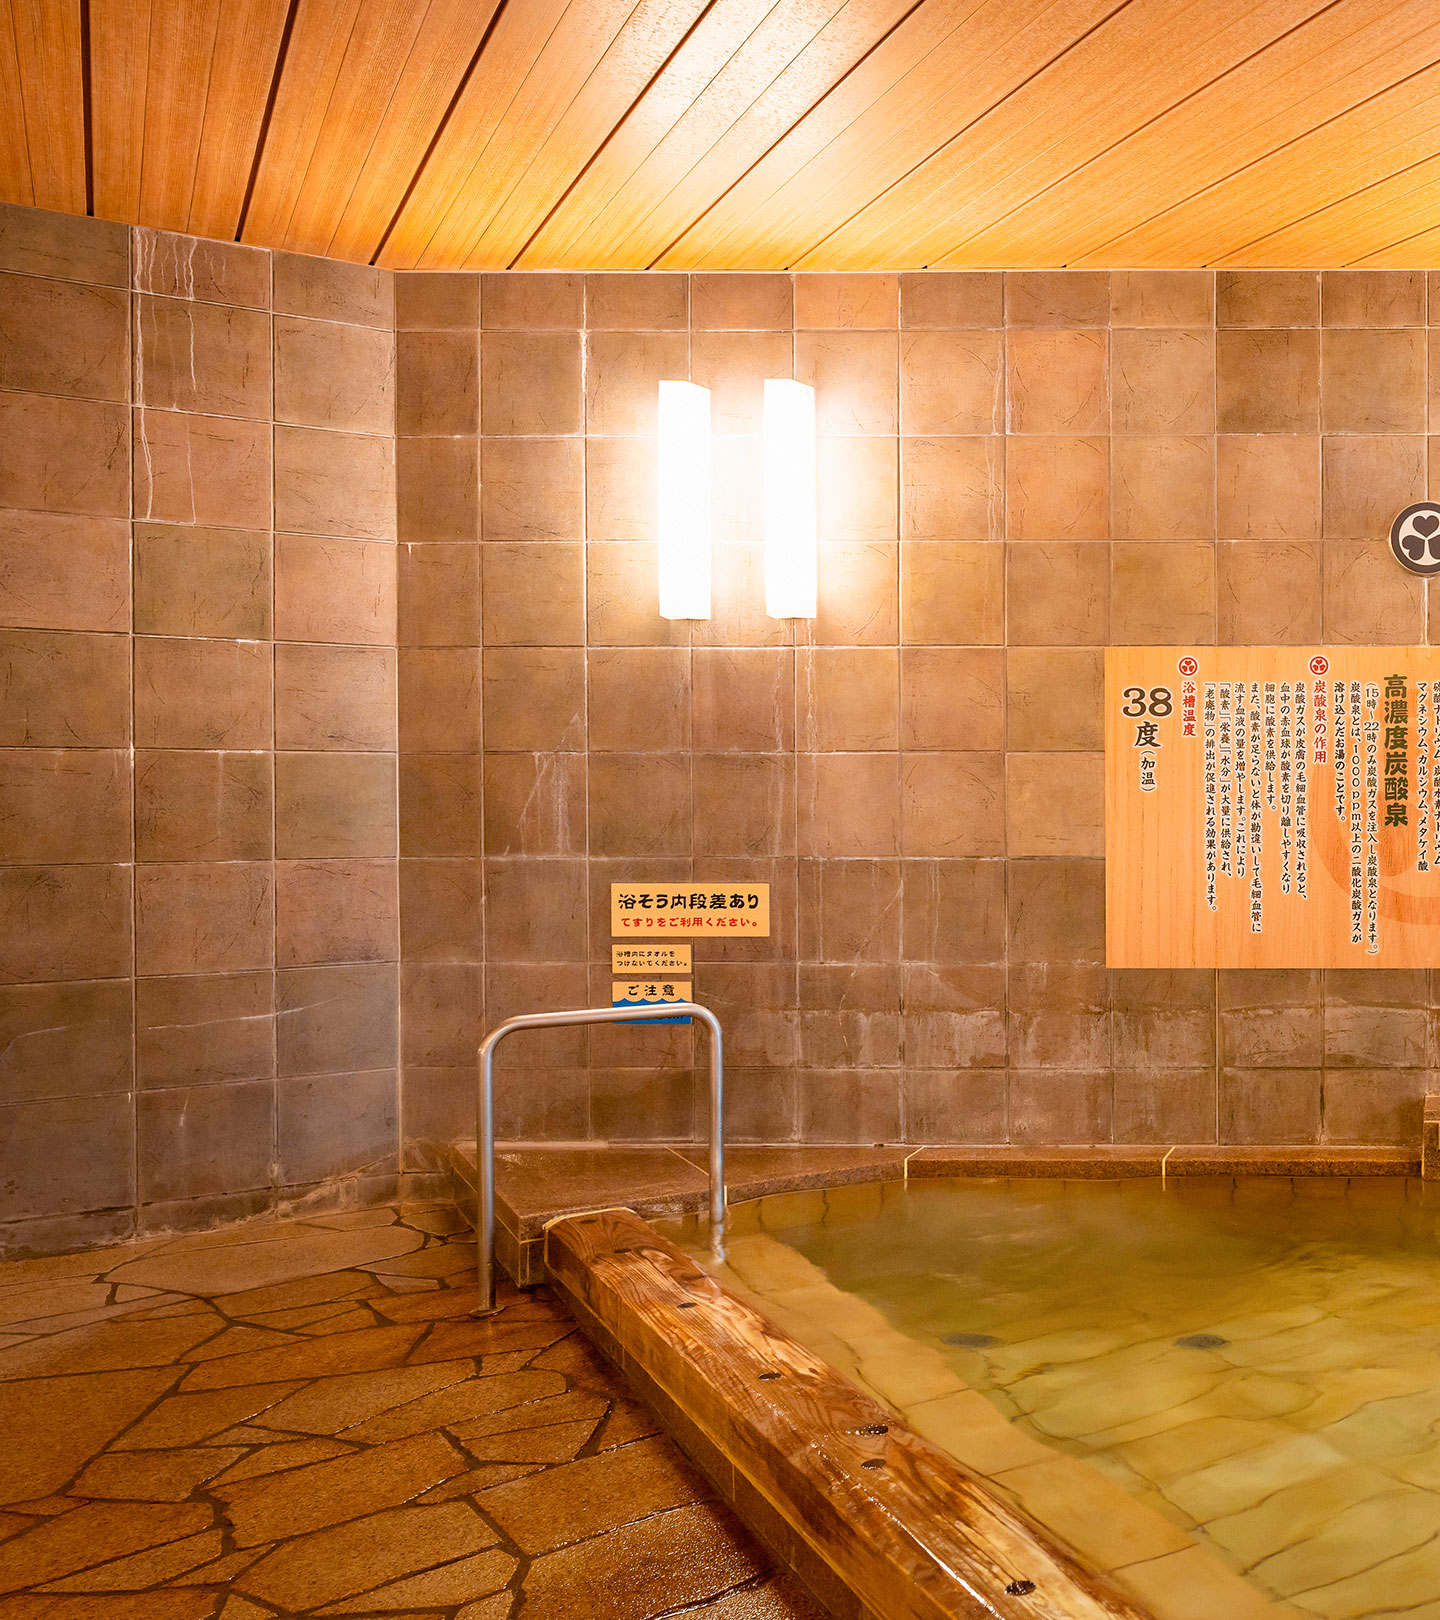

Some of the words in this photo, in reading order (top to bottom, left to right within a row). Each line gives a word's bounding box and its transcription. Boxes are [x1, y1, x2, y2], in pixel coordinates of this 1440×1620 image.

[1182, 680, 1197, 737] 浴槽温度
[1235, 682, 1247, 878] 流す血液の量を増やします。これにより
[1264, 682, 1277, 811] 細胞に酸素を供給します。
[1313, 680, 1327, 763] 炭酸泉の作用
[1334, 682, 1346, 822] 溶け込んだお湯のことです。
[1384, 674, 1408, 827] 高濃度炭酸泉
[1417, 682, 1429, 872] マグネシウム、カルシウム、メタケイ酸
[1204, 682, 1218, 912] 「老廃物」の排出が促進される効果があります。
[1250, 682, 1262, 932] また、酸素が足らないと体が勘違いして毛細血管に
[1280, 682, 1292, 894] 血中の赤血球が酸素を切り離しやすくなり
[1294, 682, 1307, 899] 炭酸ガスが皮膚の毛細血管に吸収されると、
[618, 893, 760, 910] 浴そう内段差あり
[620, 917, 758, 928] てすりをご利用ください。
[627, 984, 675, 997] ご注意
